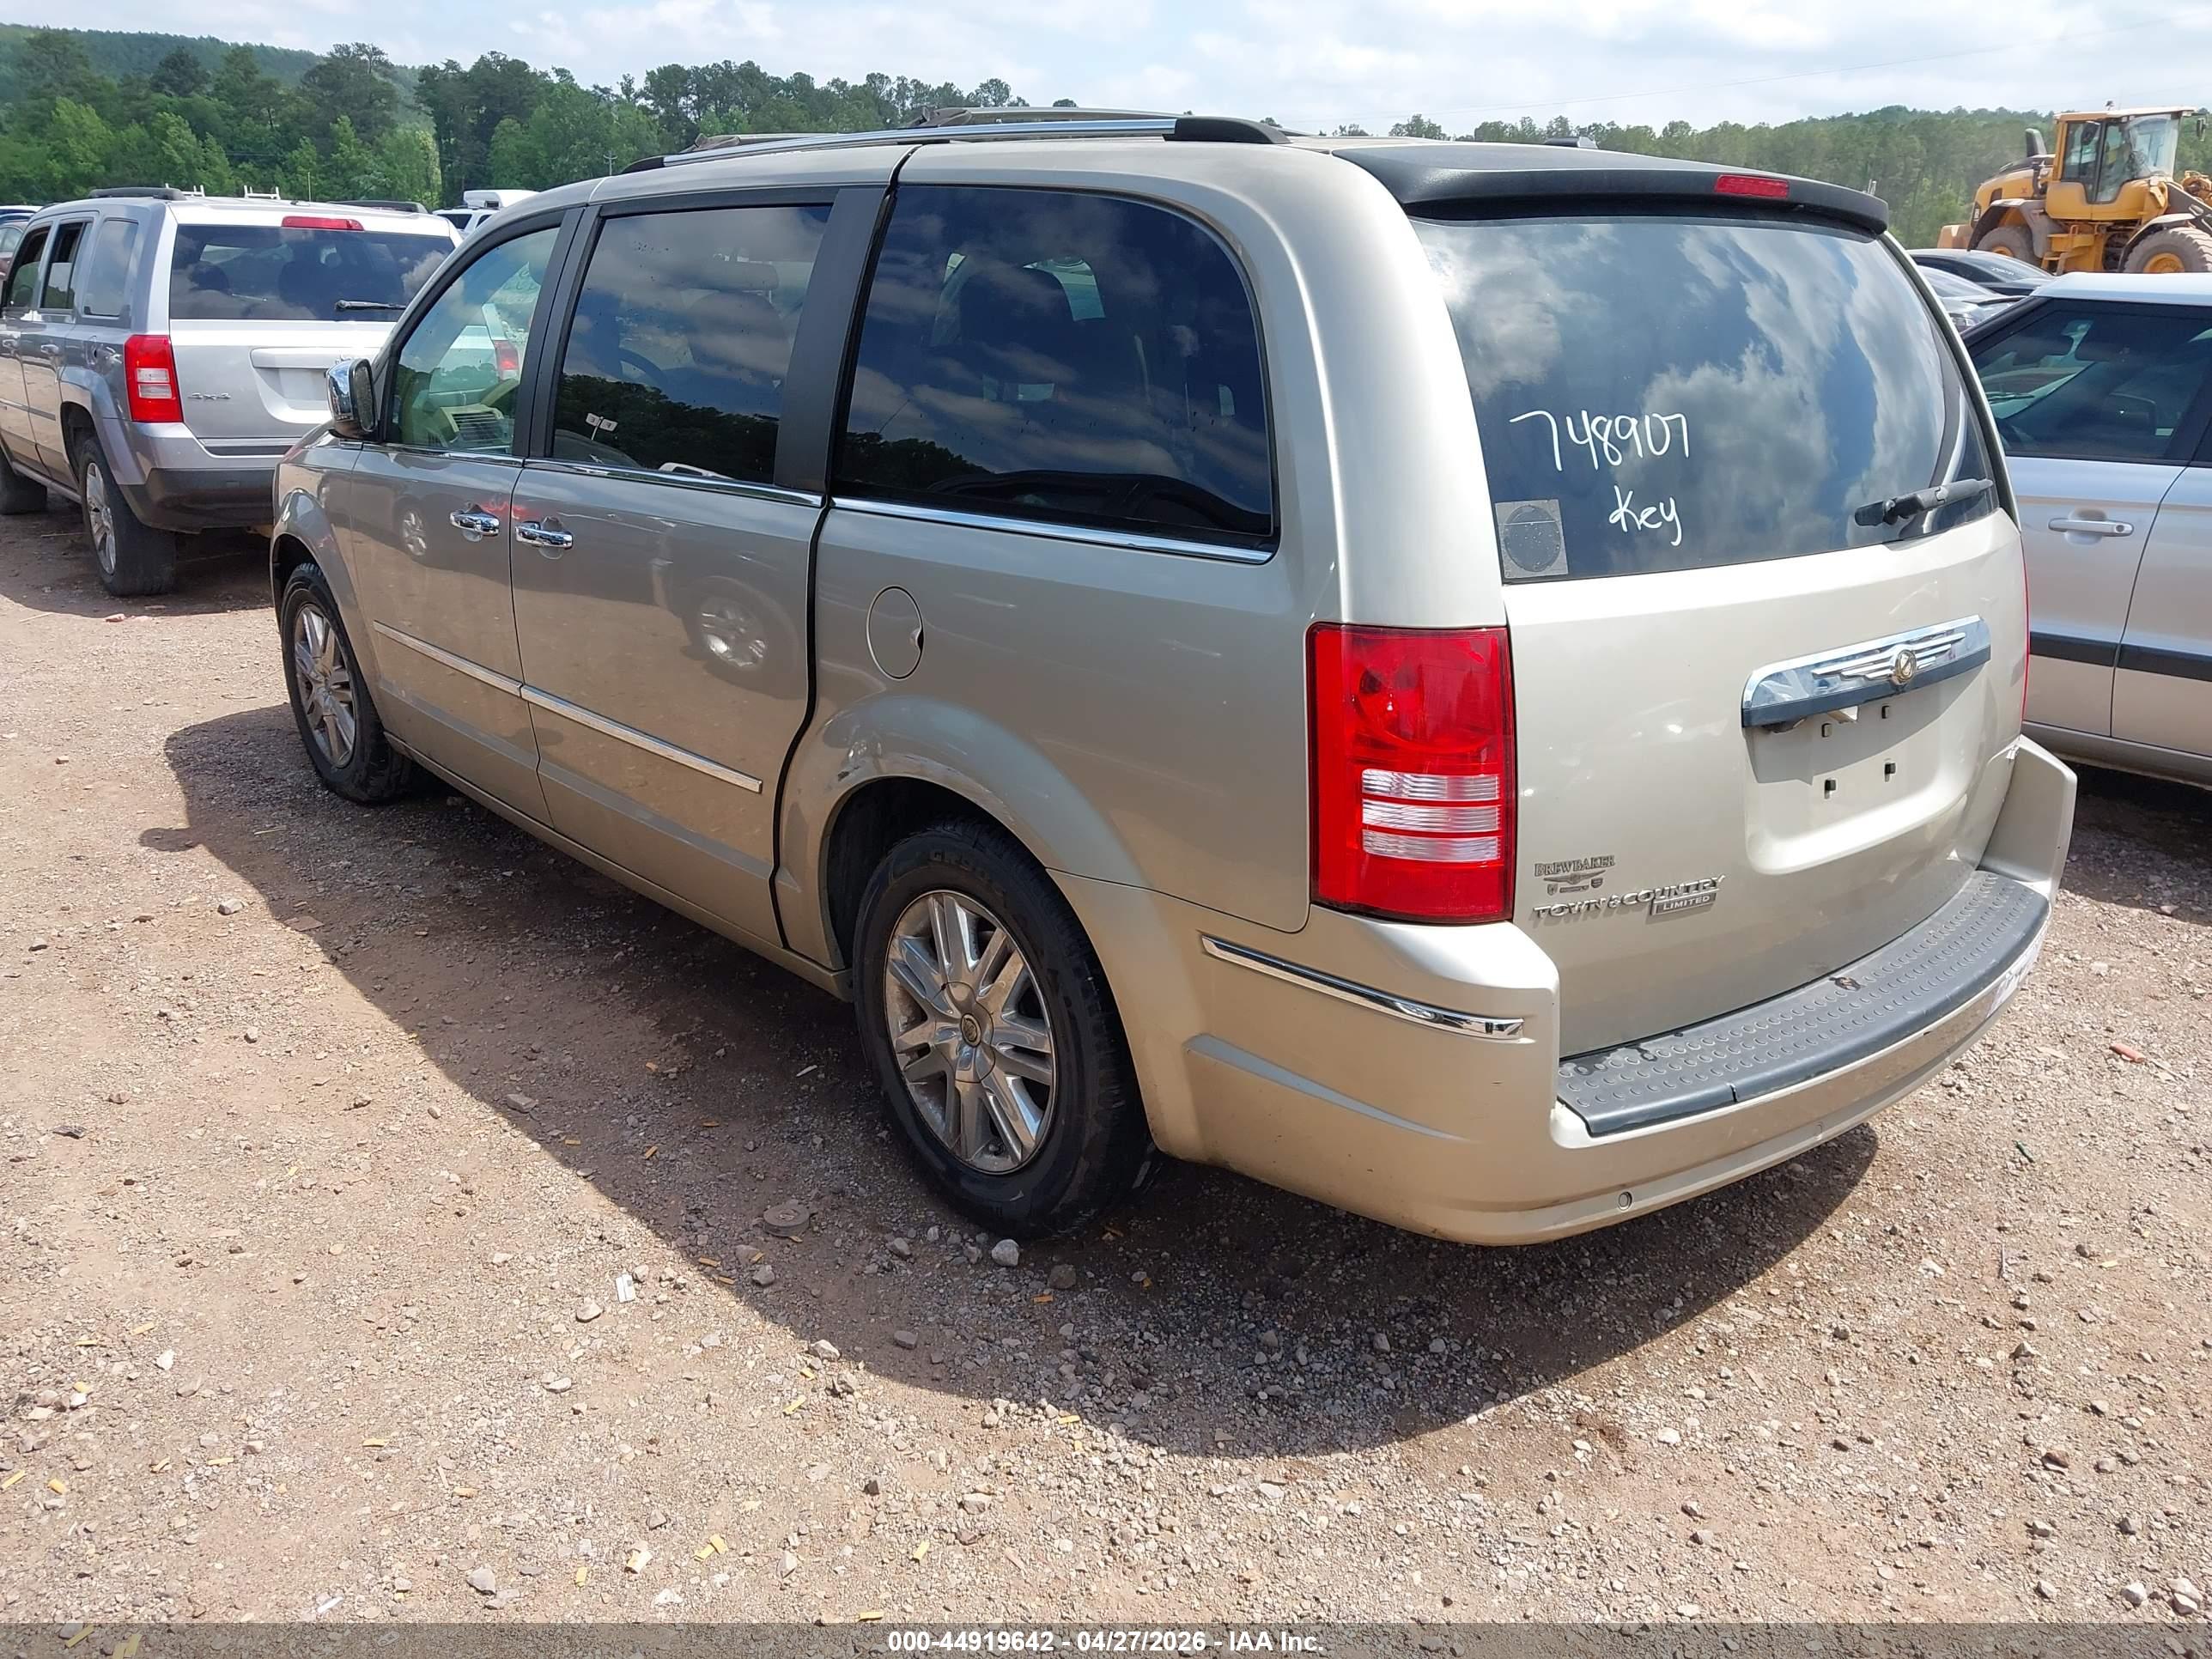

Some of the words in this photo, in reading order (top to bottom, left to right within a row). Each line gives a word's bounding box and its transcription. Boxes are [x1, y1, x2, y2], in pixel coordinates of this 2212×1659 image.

[1509, 410, 1689, 471] 748907
[1608, 484, 1683, 547] Key
[1534, 854, 1615, 877] BREWBAKER
[1533, 897, 1606, 918] TOWN
[1621, 874, 1726, 906] COUNTRY
[1662, 895, 1711, 910] LIMITED
